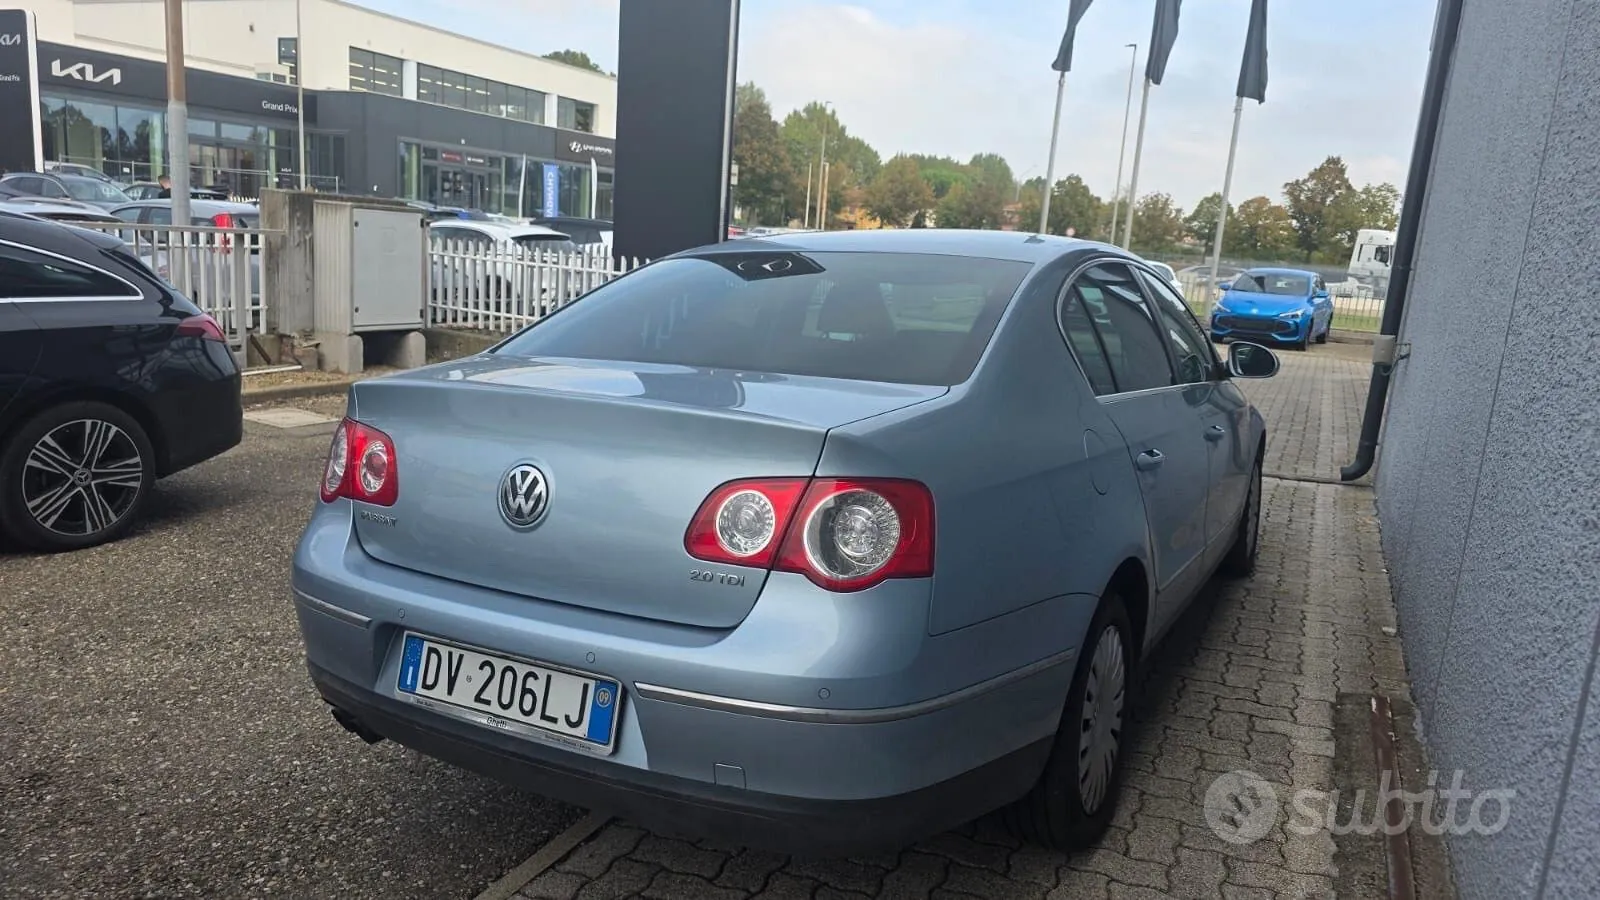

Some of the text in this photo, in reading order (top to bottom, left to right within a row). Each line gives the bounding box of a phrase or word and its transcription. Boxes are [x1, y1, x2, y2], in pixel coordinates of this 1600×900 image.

[262, 100, 284, 112] Grand
[717, 572, 745, 587] TDI
[421, 646, 590, 729] DV 206LJ
[598, 691, 609, 703] 09
